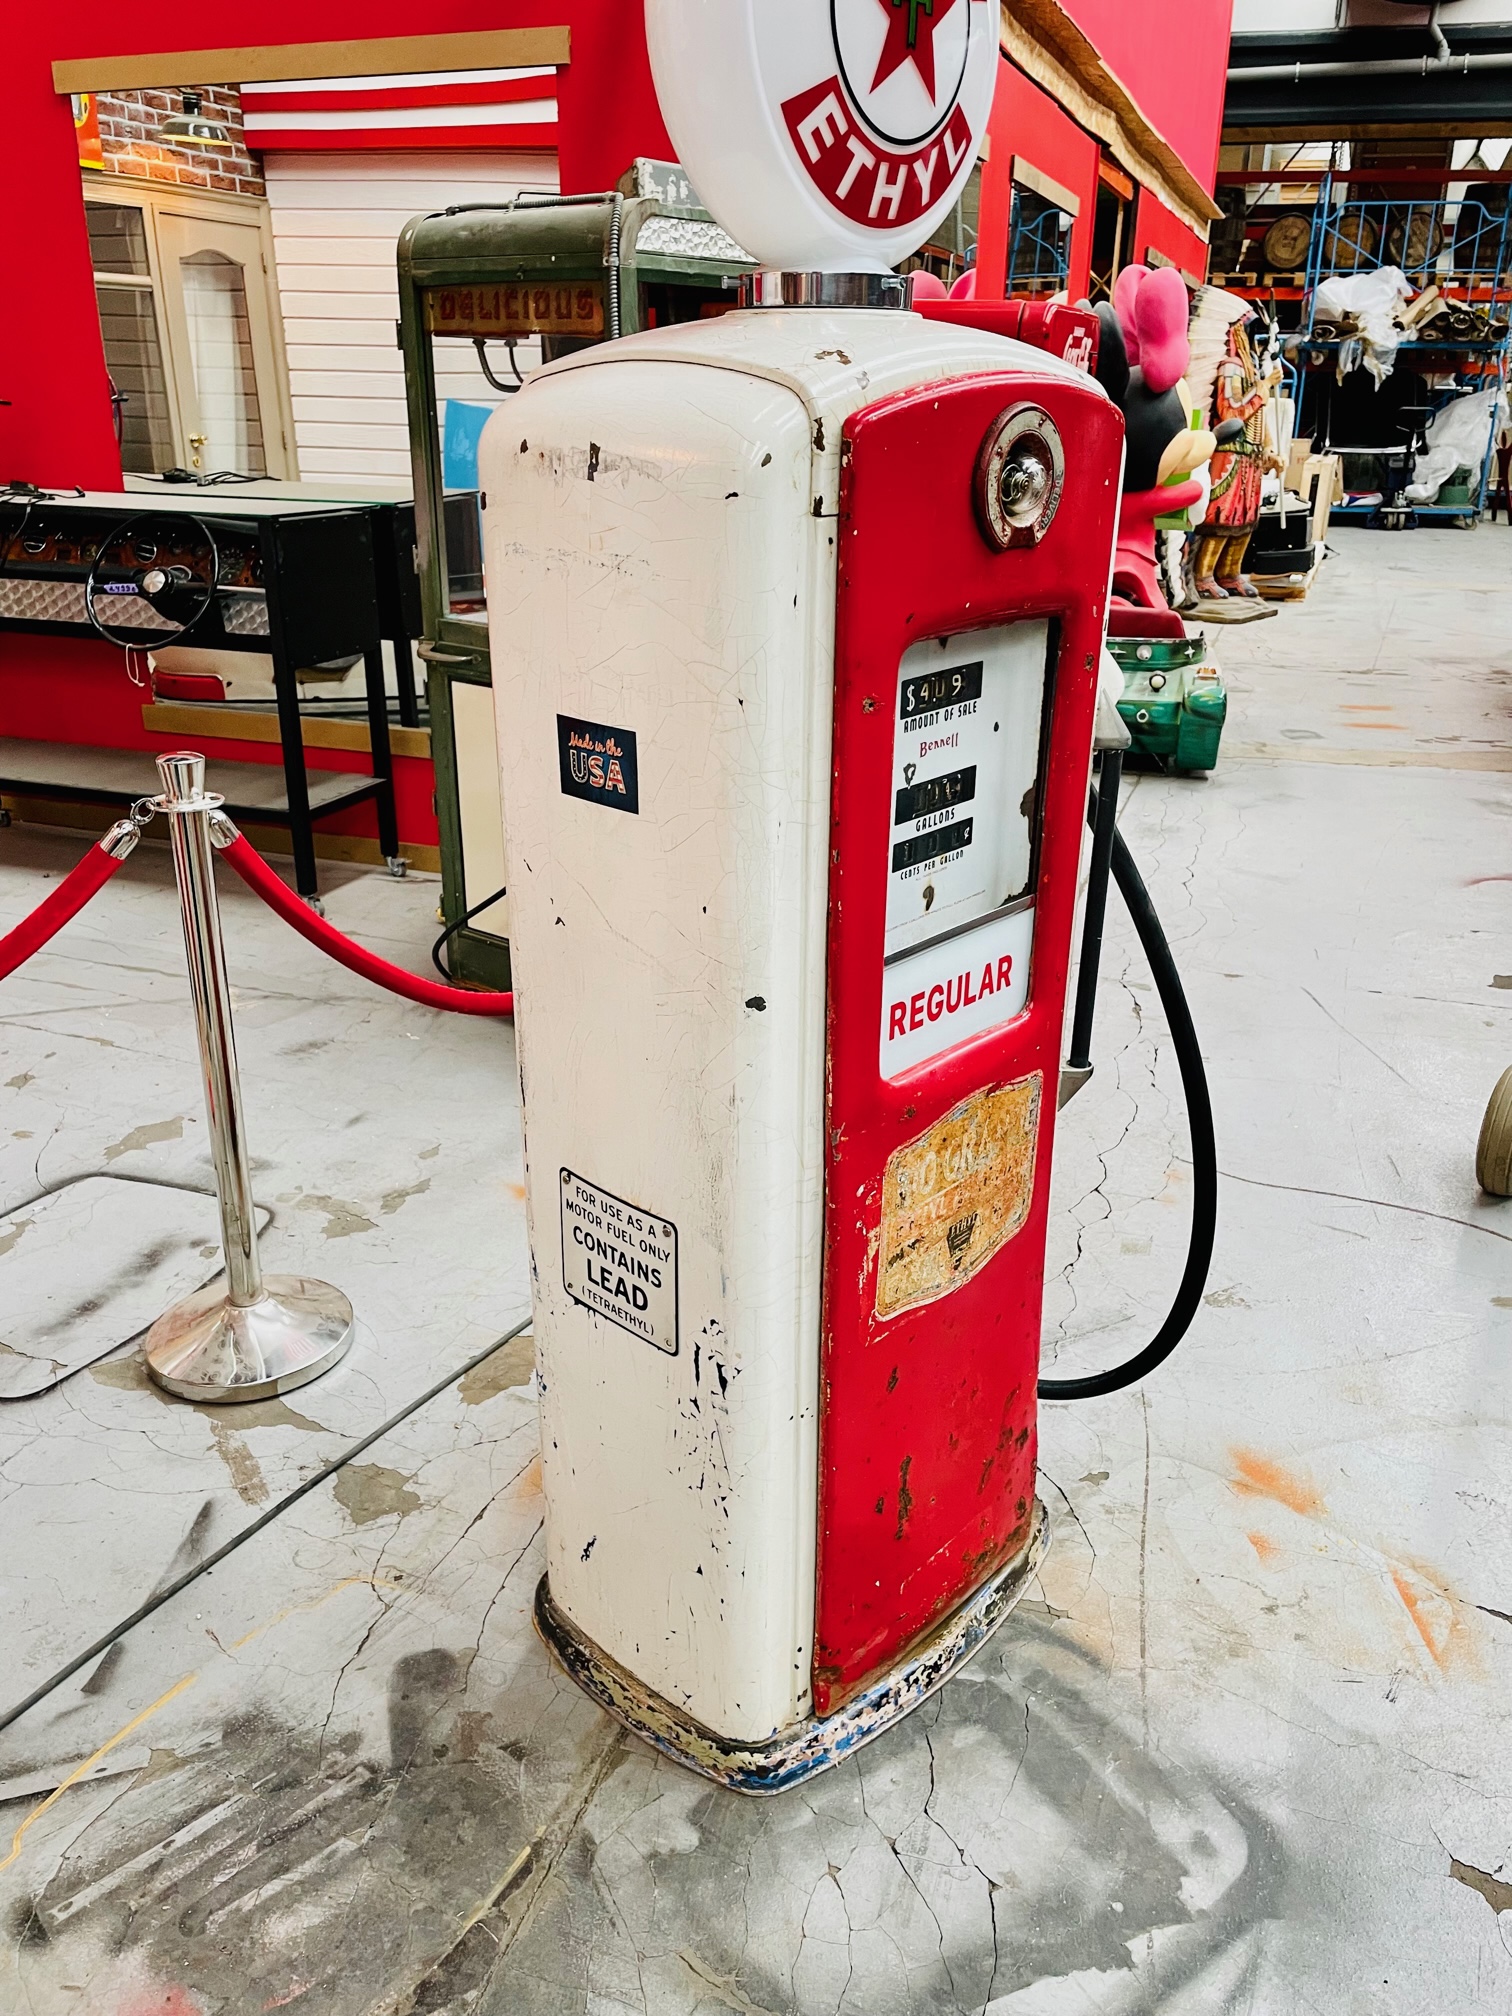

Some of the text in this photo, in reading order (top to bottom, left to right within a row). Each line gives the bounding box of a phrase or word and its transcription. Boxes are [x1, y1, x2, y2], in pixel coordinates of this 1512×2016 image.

[796, 91, 968, 220] ETHYL
[440, 288, 594, 321] DELICIOUS
[903, 701, 977, 734] AMOUNT OF SALE
[568, 731, 623, 757] Made in the
[570, 748, 627, 795] USA
[915, 807, 955, 832] GALLONS
[900, 866, 920, 881] CENTS
[923, 860, 936, 872] PER
[939, 849, 964, 865] GALLON
[888, 954, 1013, 1041] REGULAR
[565, 1198, 671, 1263] MOTOR FUEL ONLY
[575, 1185, 657, 1239] FOR USE AS A
[573, 1225, 662, 1289] CONTAINS
[586, 1258, 649, 1311] LEAD
[582, 1285, 655, 1336] (TETRAETHYL)
